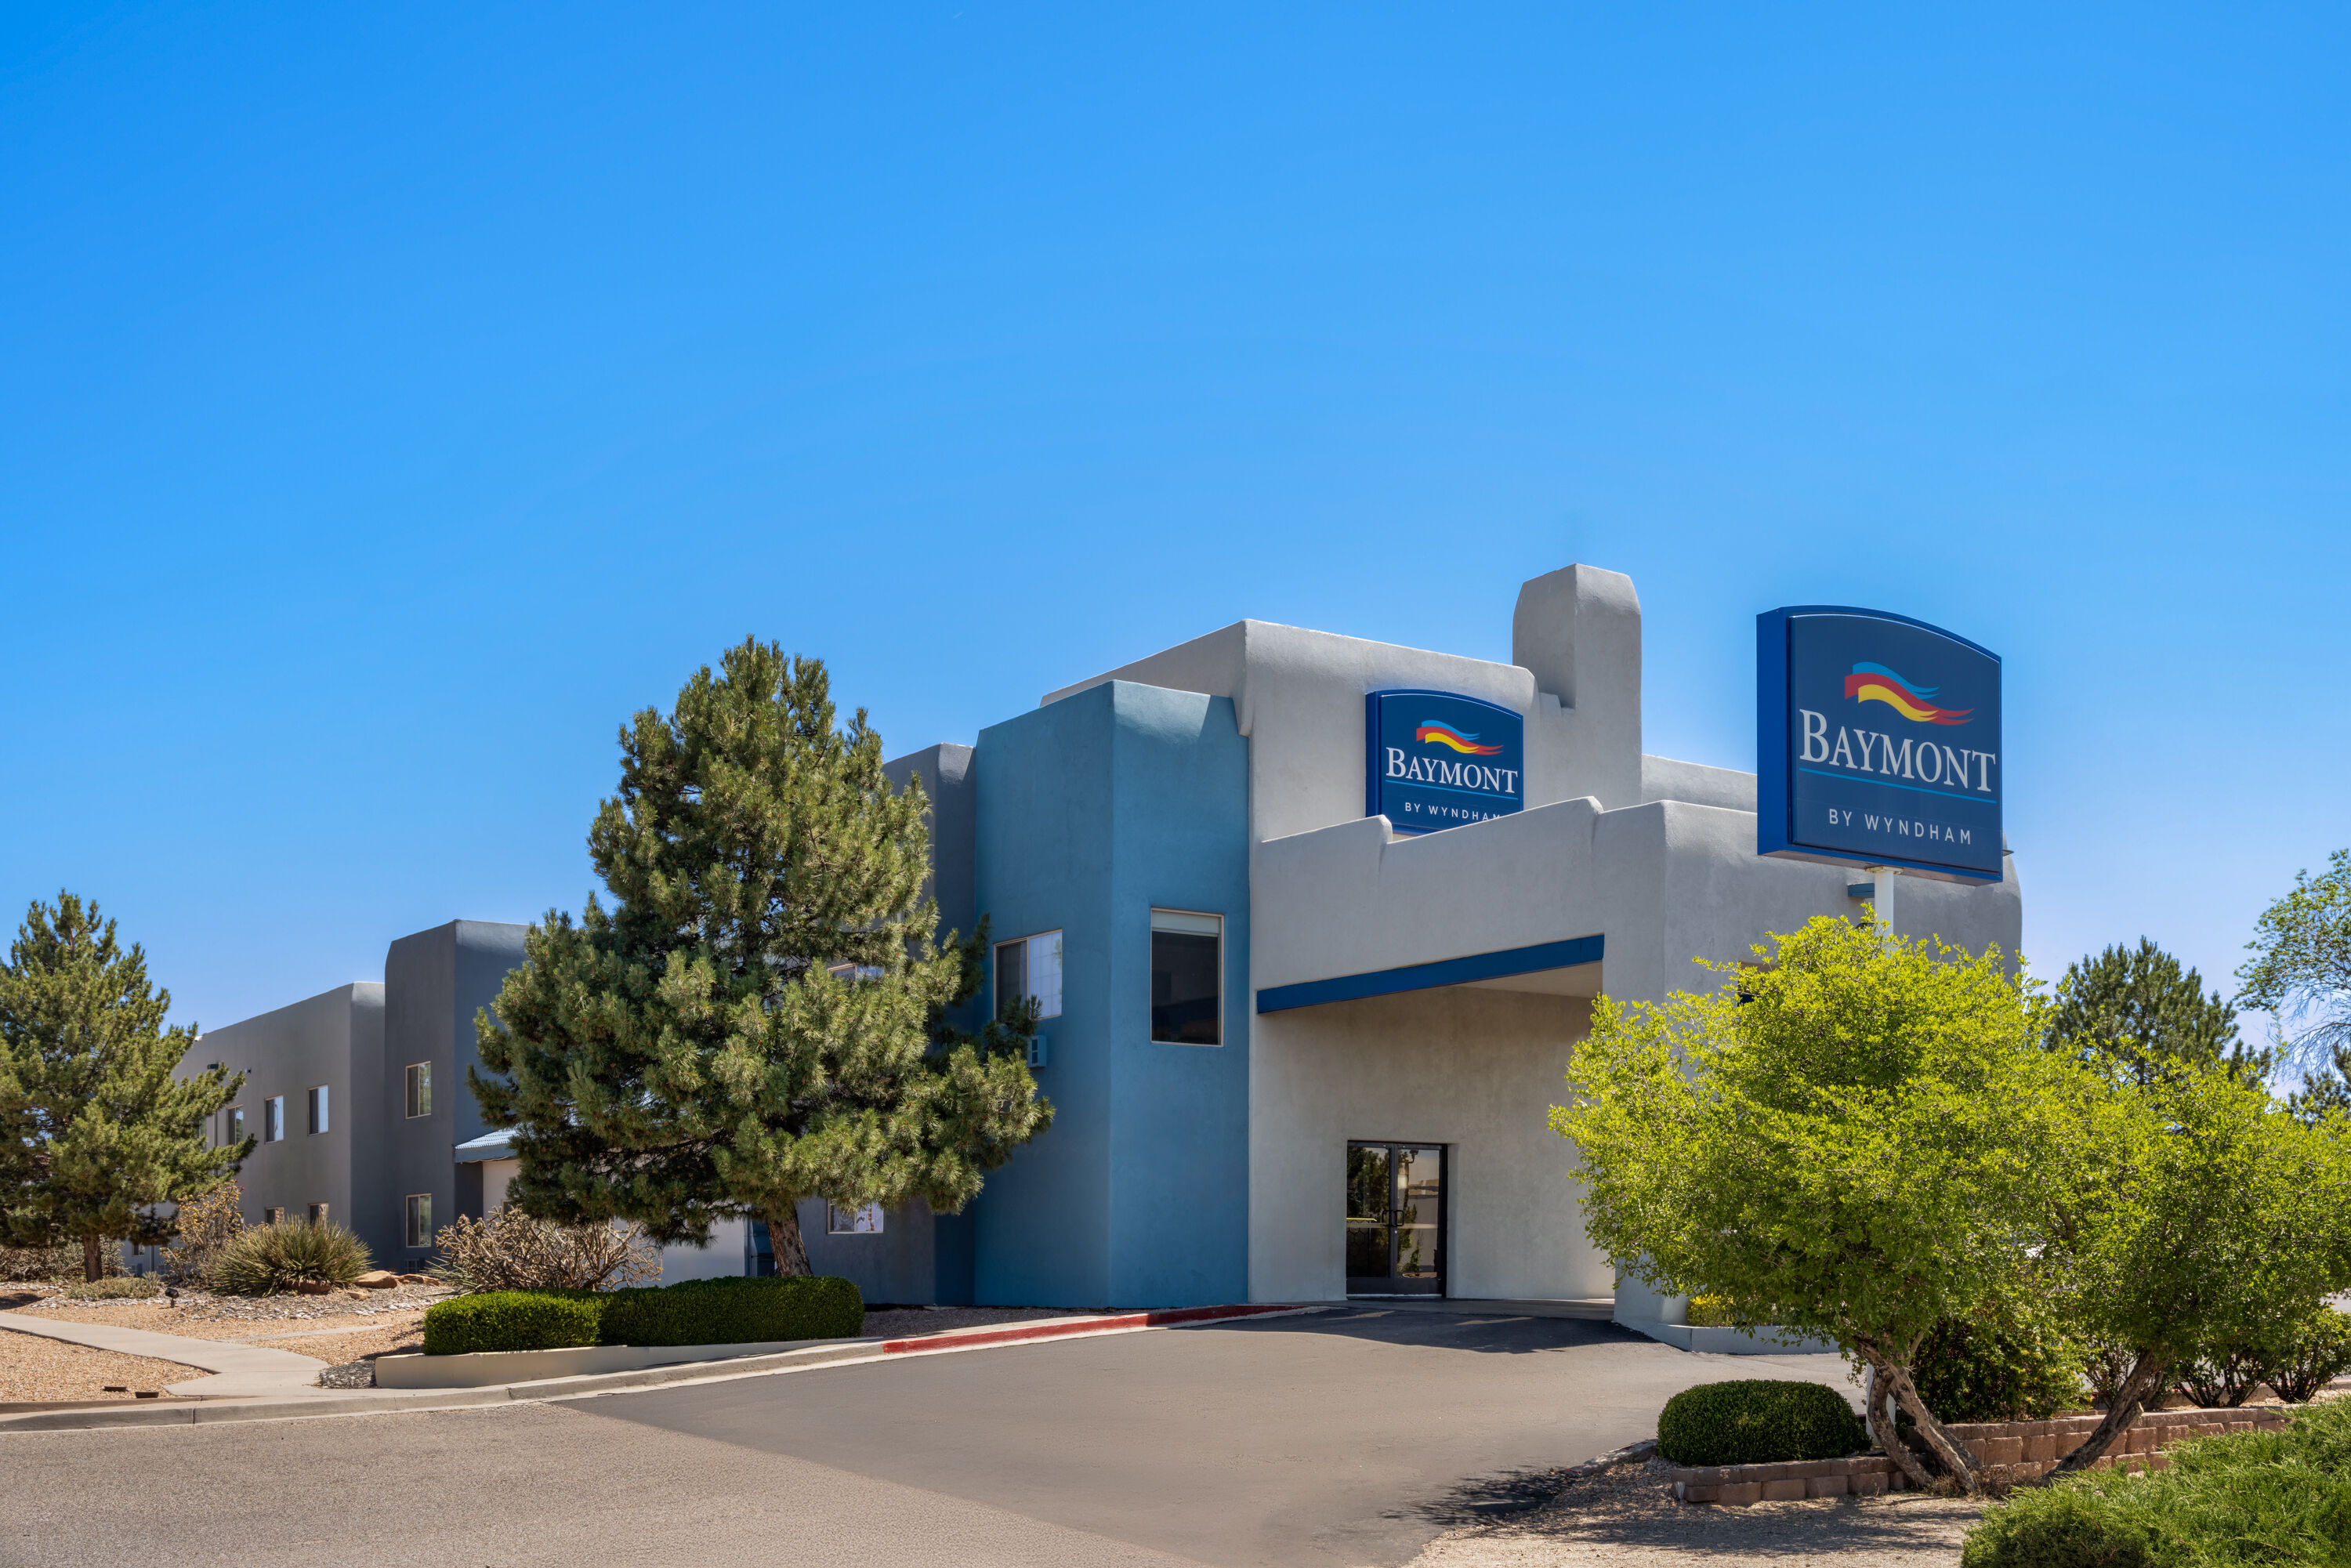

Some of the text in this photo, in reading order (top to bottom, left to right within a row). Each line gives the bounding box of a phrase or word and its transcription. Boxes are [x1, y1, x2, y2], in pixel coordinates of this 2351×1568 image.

[1386, 747, 1519, 793] BAYMONT
[1799, 708, 1996, 792] BAYMONT
[1404, 802, 1421, 813] BY
[1829, 809, 1971, 845] BY WYNDHAM
